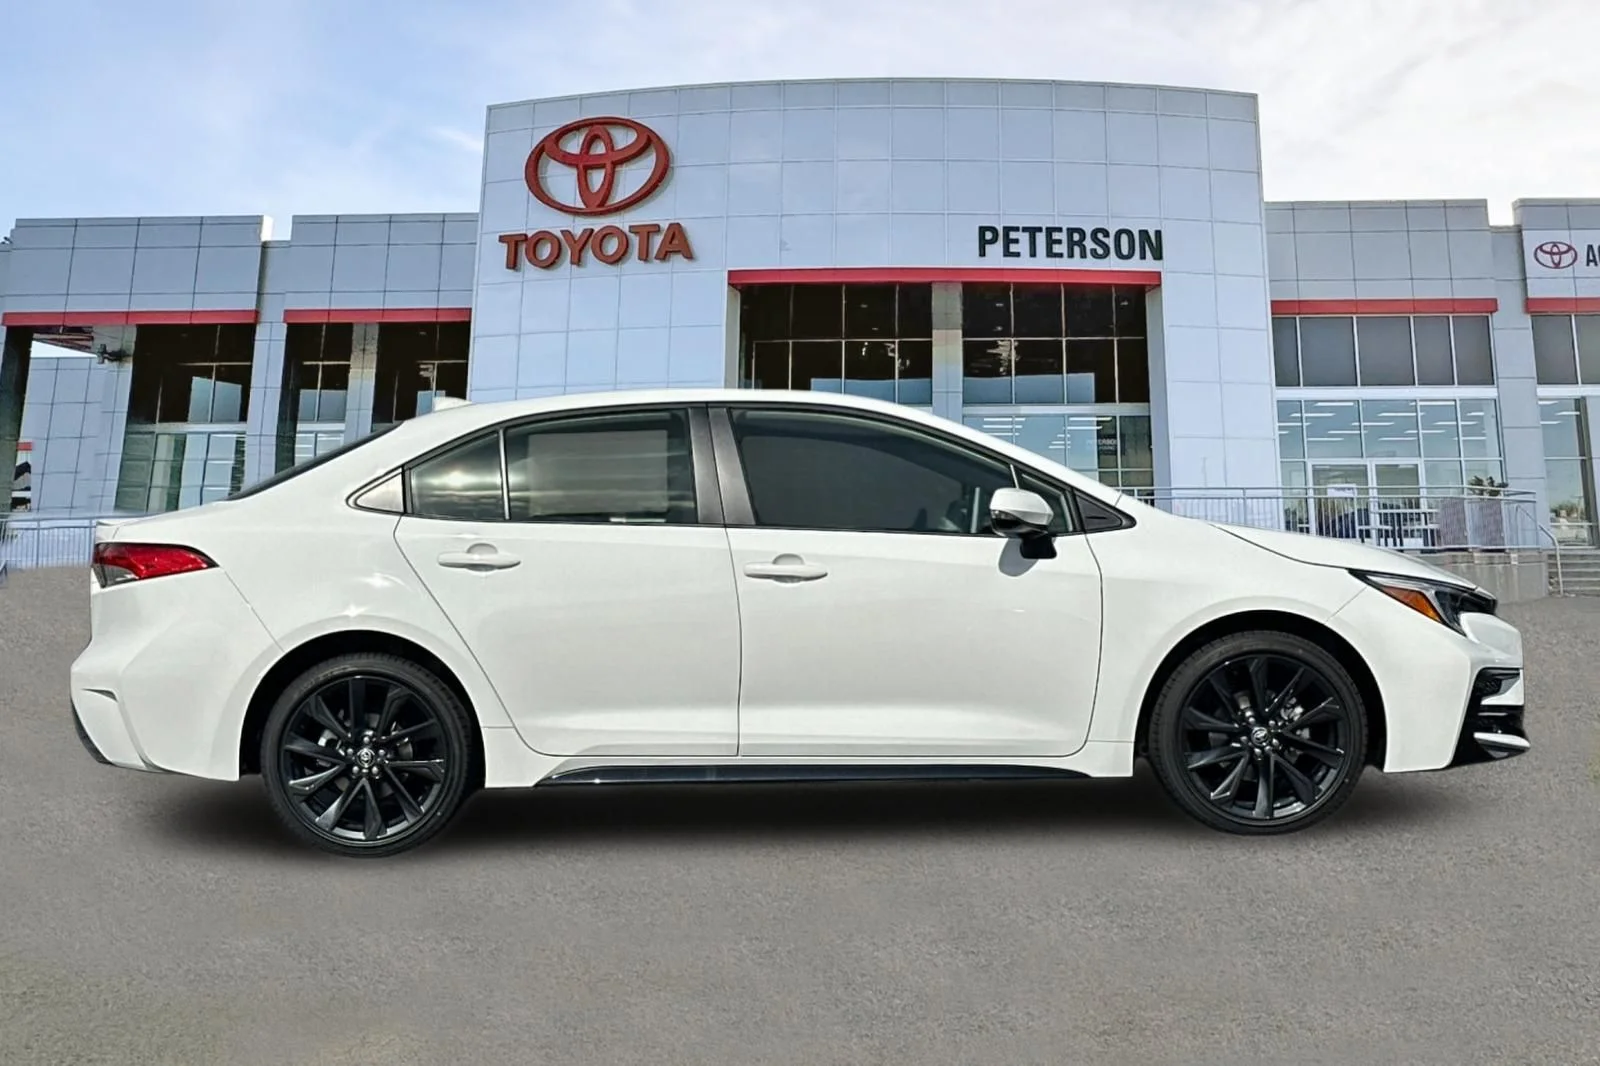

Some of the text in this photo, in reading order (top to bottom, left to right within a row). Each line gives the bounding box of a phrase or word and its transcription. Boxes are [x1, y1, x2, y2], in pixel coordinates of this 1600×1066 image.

[499, 223, 693, 269] TOYOTA
[978, 226, 1163, 260] PETERSON
[1586, 244, 1600, 267] A
